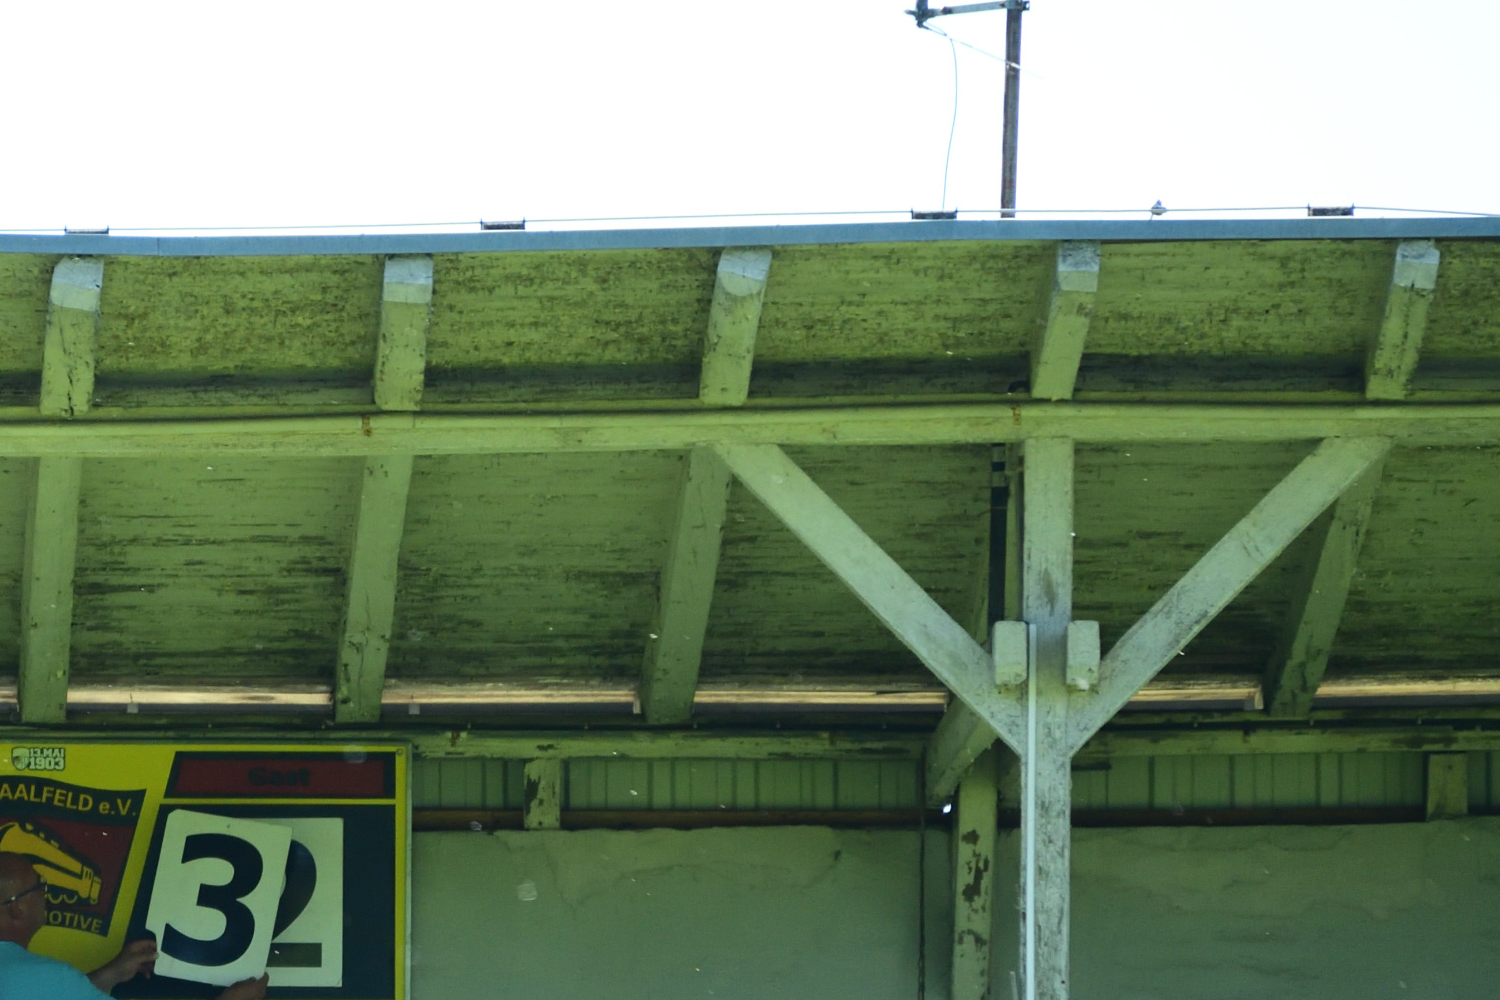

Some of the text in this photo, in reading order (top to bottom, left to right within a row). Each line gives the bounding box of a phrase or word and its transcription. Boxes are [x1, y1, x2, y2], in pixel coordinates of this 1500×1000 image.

[29, 757, 65, 770] 1903
[99, 798, 137, 816] e.V.
[160, 832, 264, 968] 3
[45, 910, 103, 933] OTIVE
